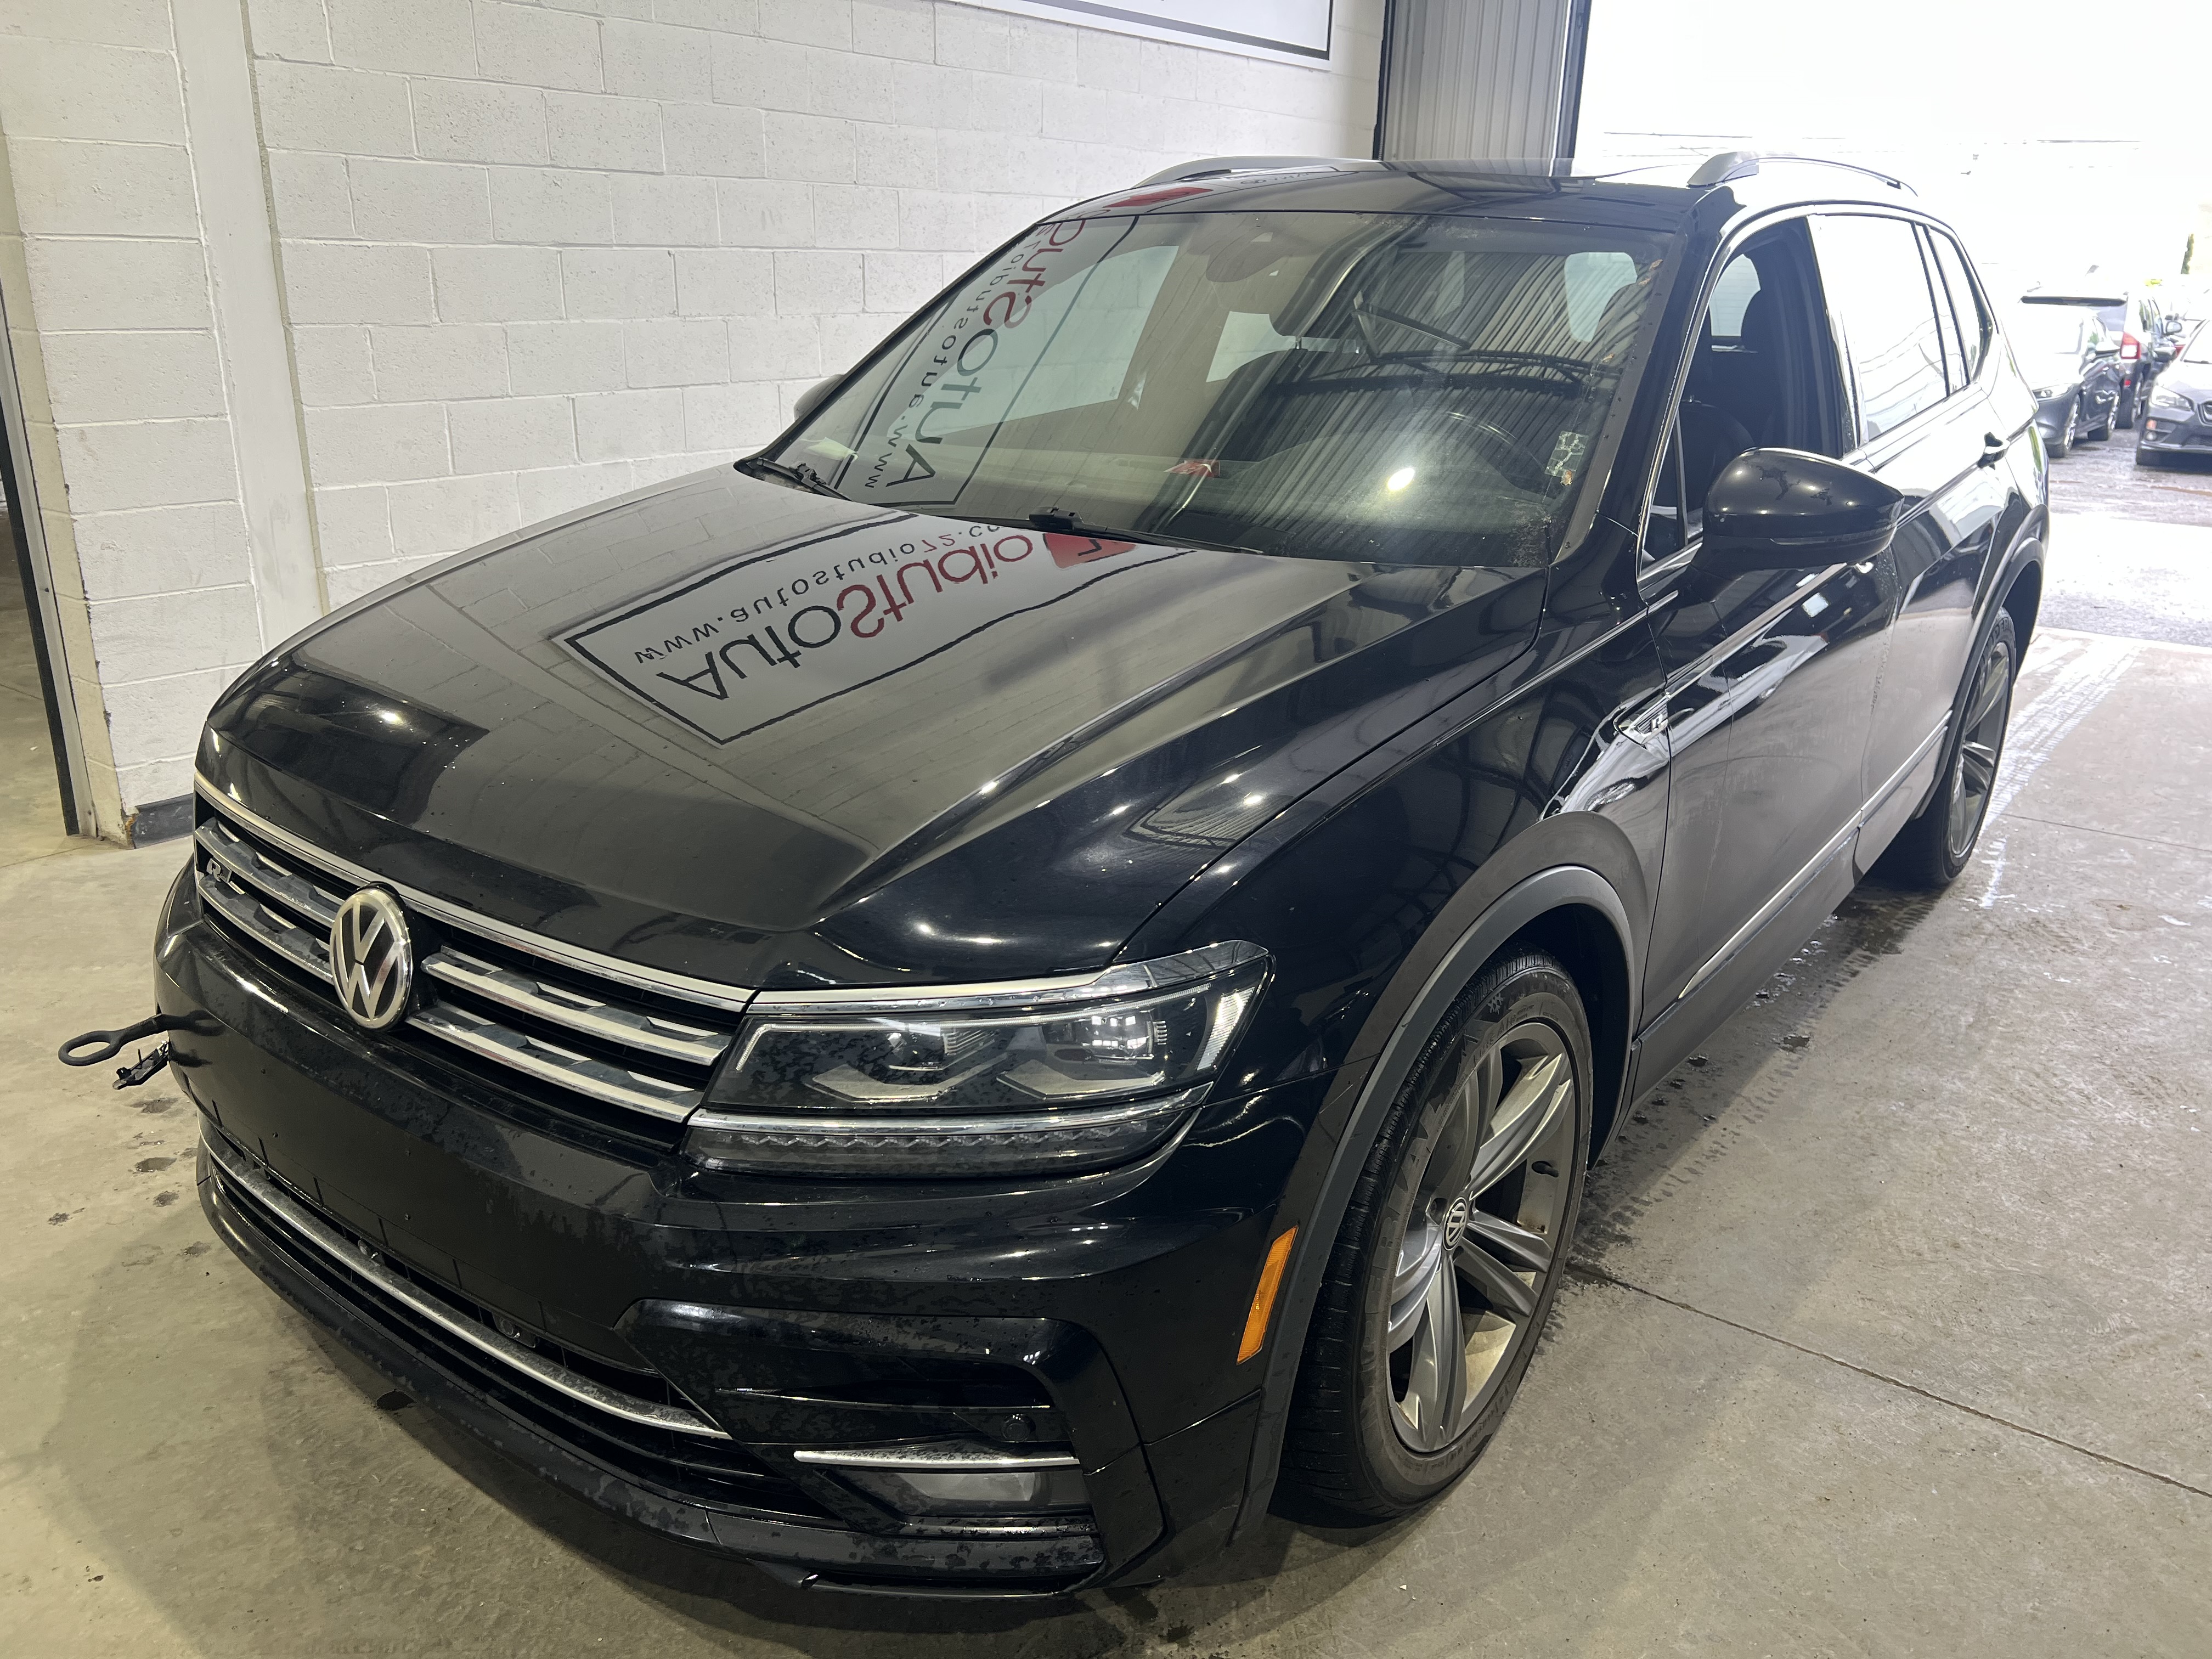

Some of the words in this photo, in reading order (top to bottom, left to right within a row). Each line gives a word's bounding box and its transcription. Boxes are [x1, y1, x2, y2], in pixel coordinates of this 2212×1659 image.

[206, 857, 221, 882] R
[331, 889, 410, 1027] VW
[1444, 1199, 1466, 1249] VW
